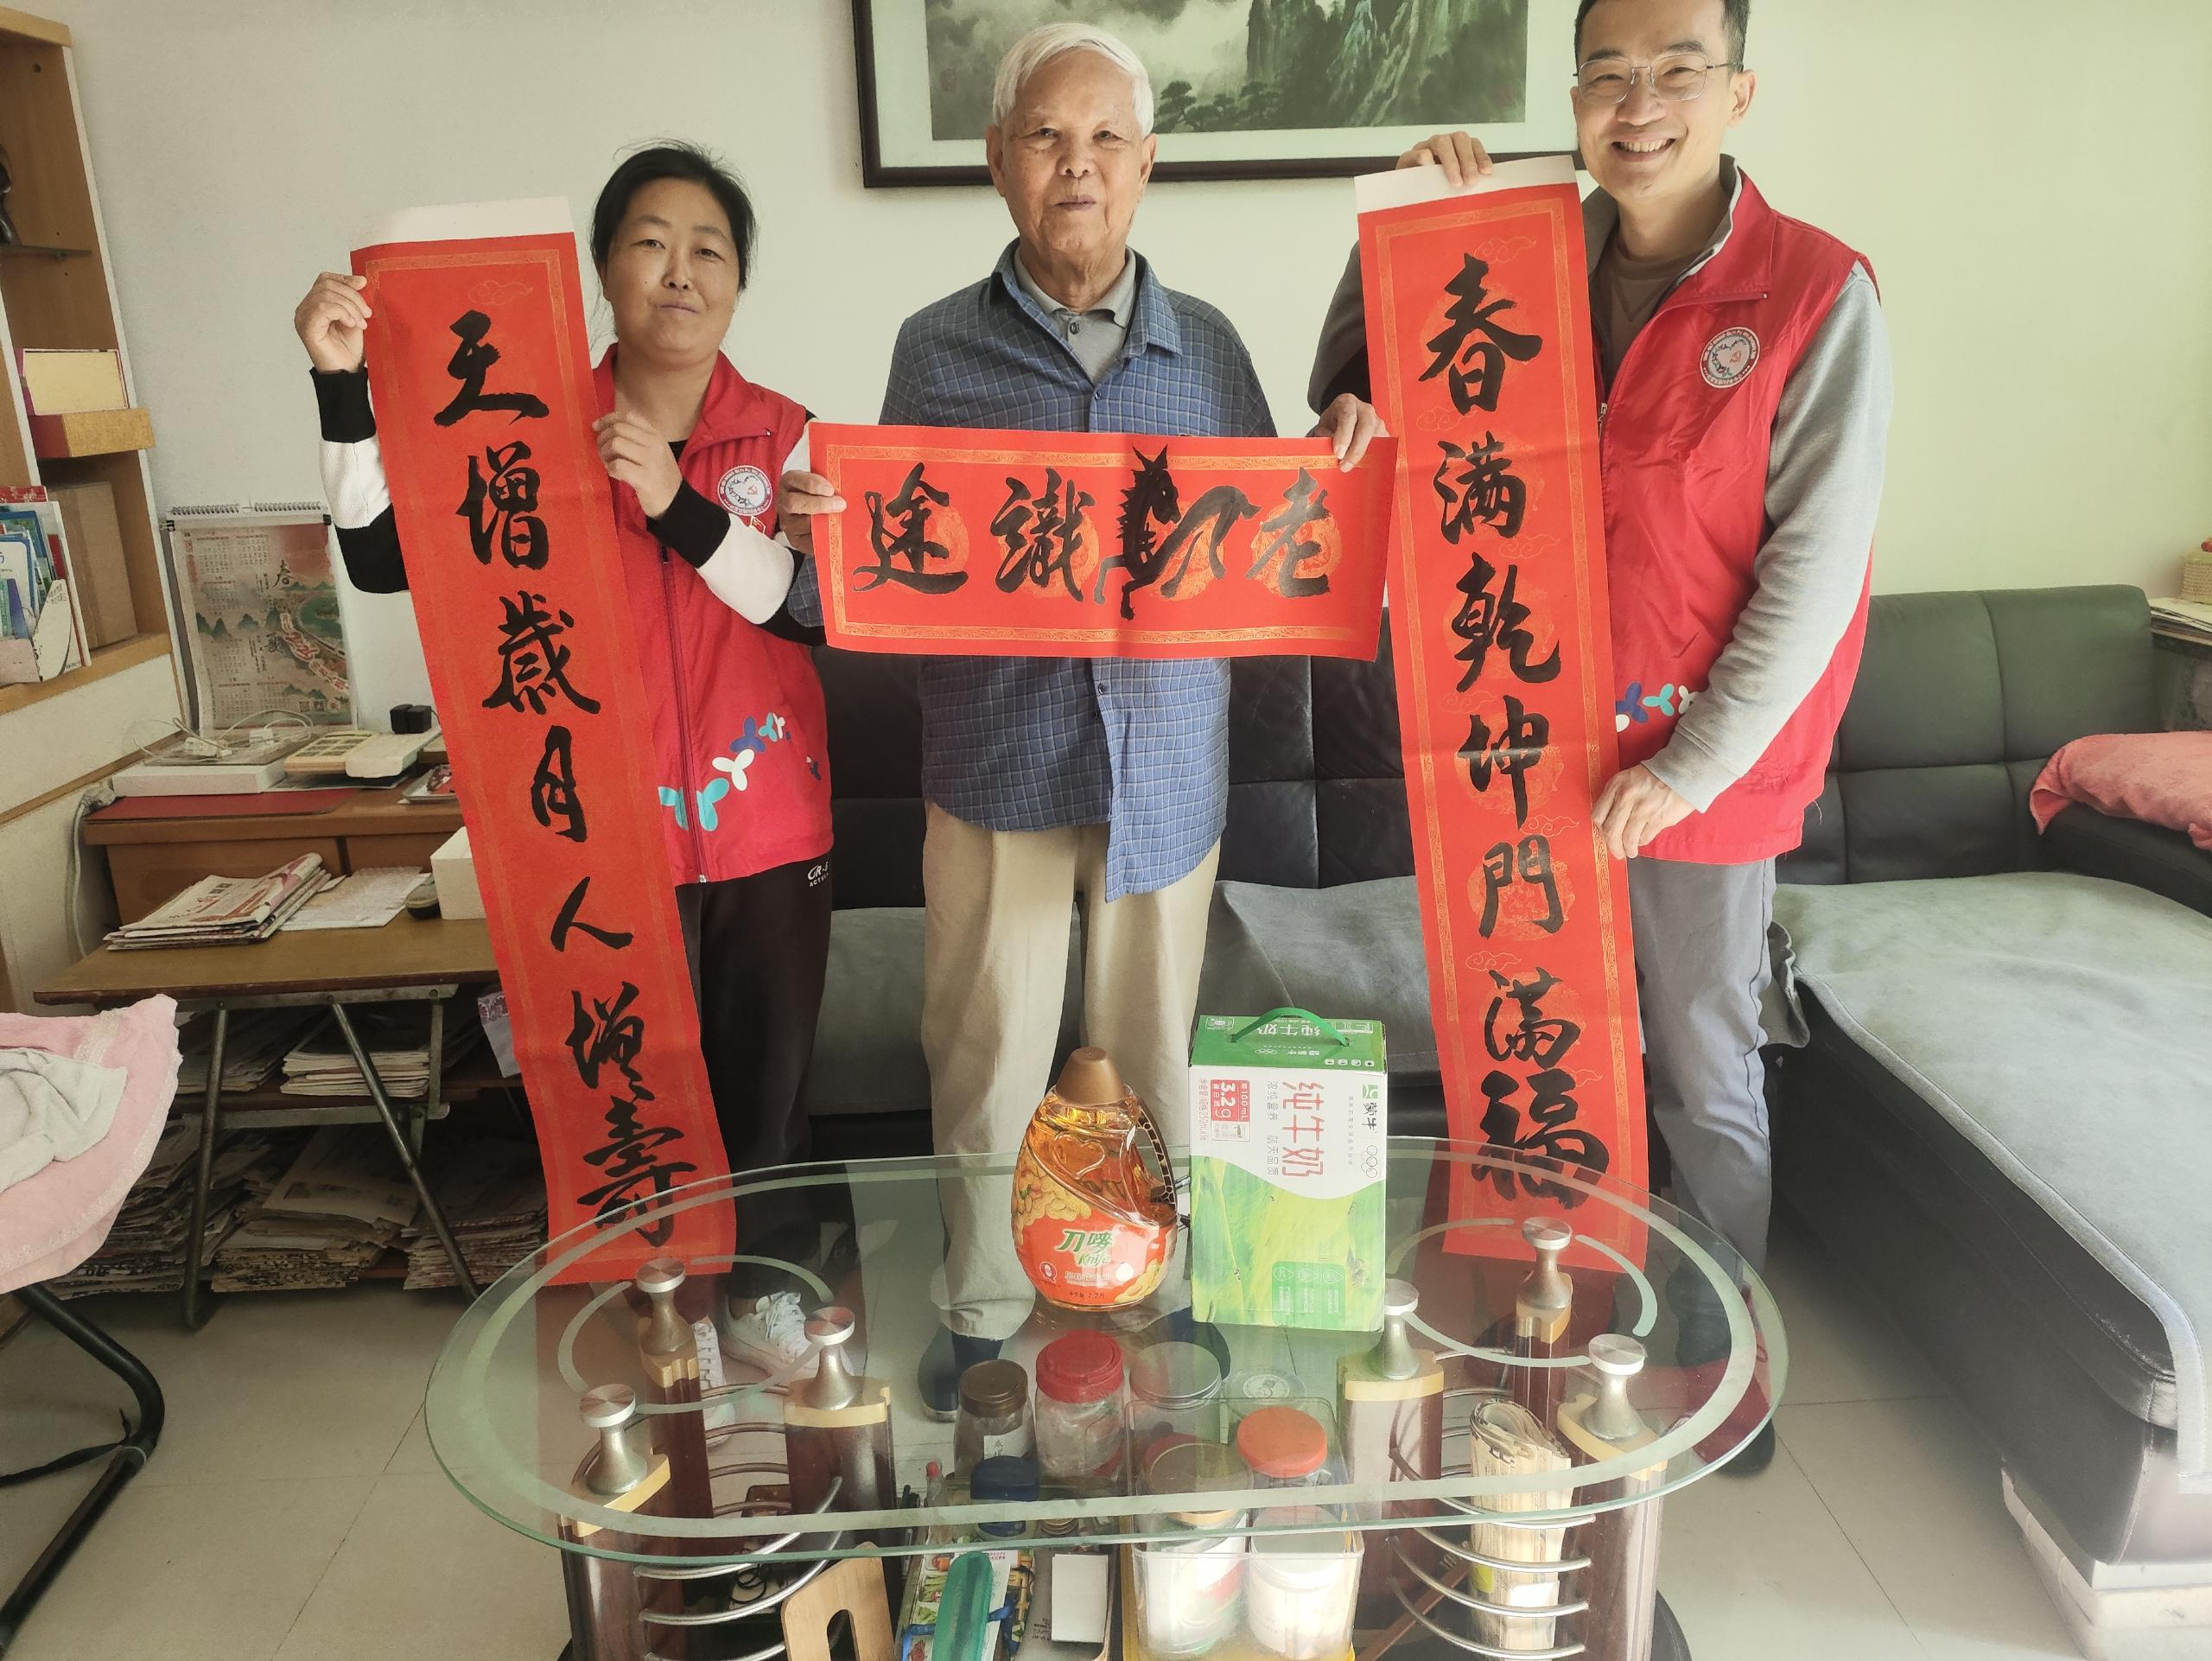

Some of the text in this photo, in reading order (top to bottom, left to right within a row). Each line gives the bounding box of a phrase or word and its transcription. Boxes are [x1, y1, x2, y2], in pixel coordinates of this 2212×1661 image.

[272, 559, 296, 588] 春
[1281, 1081, 1325, 1177] 纯牛奶
[1362, 1102, 1378, 1130] 蒙牛
[1077, 1253, 1111, 1266] Knife
